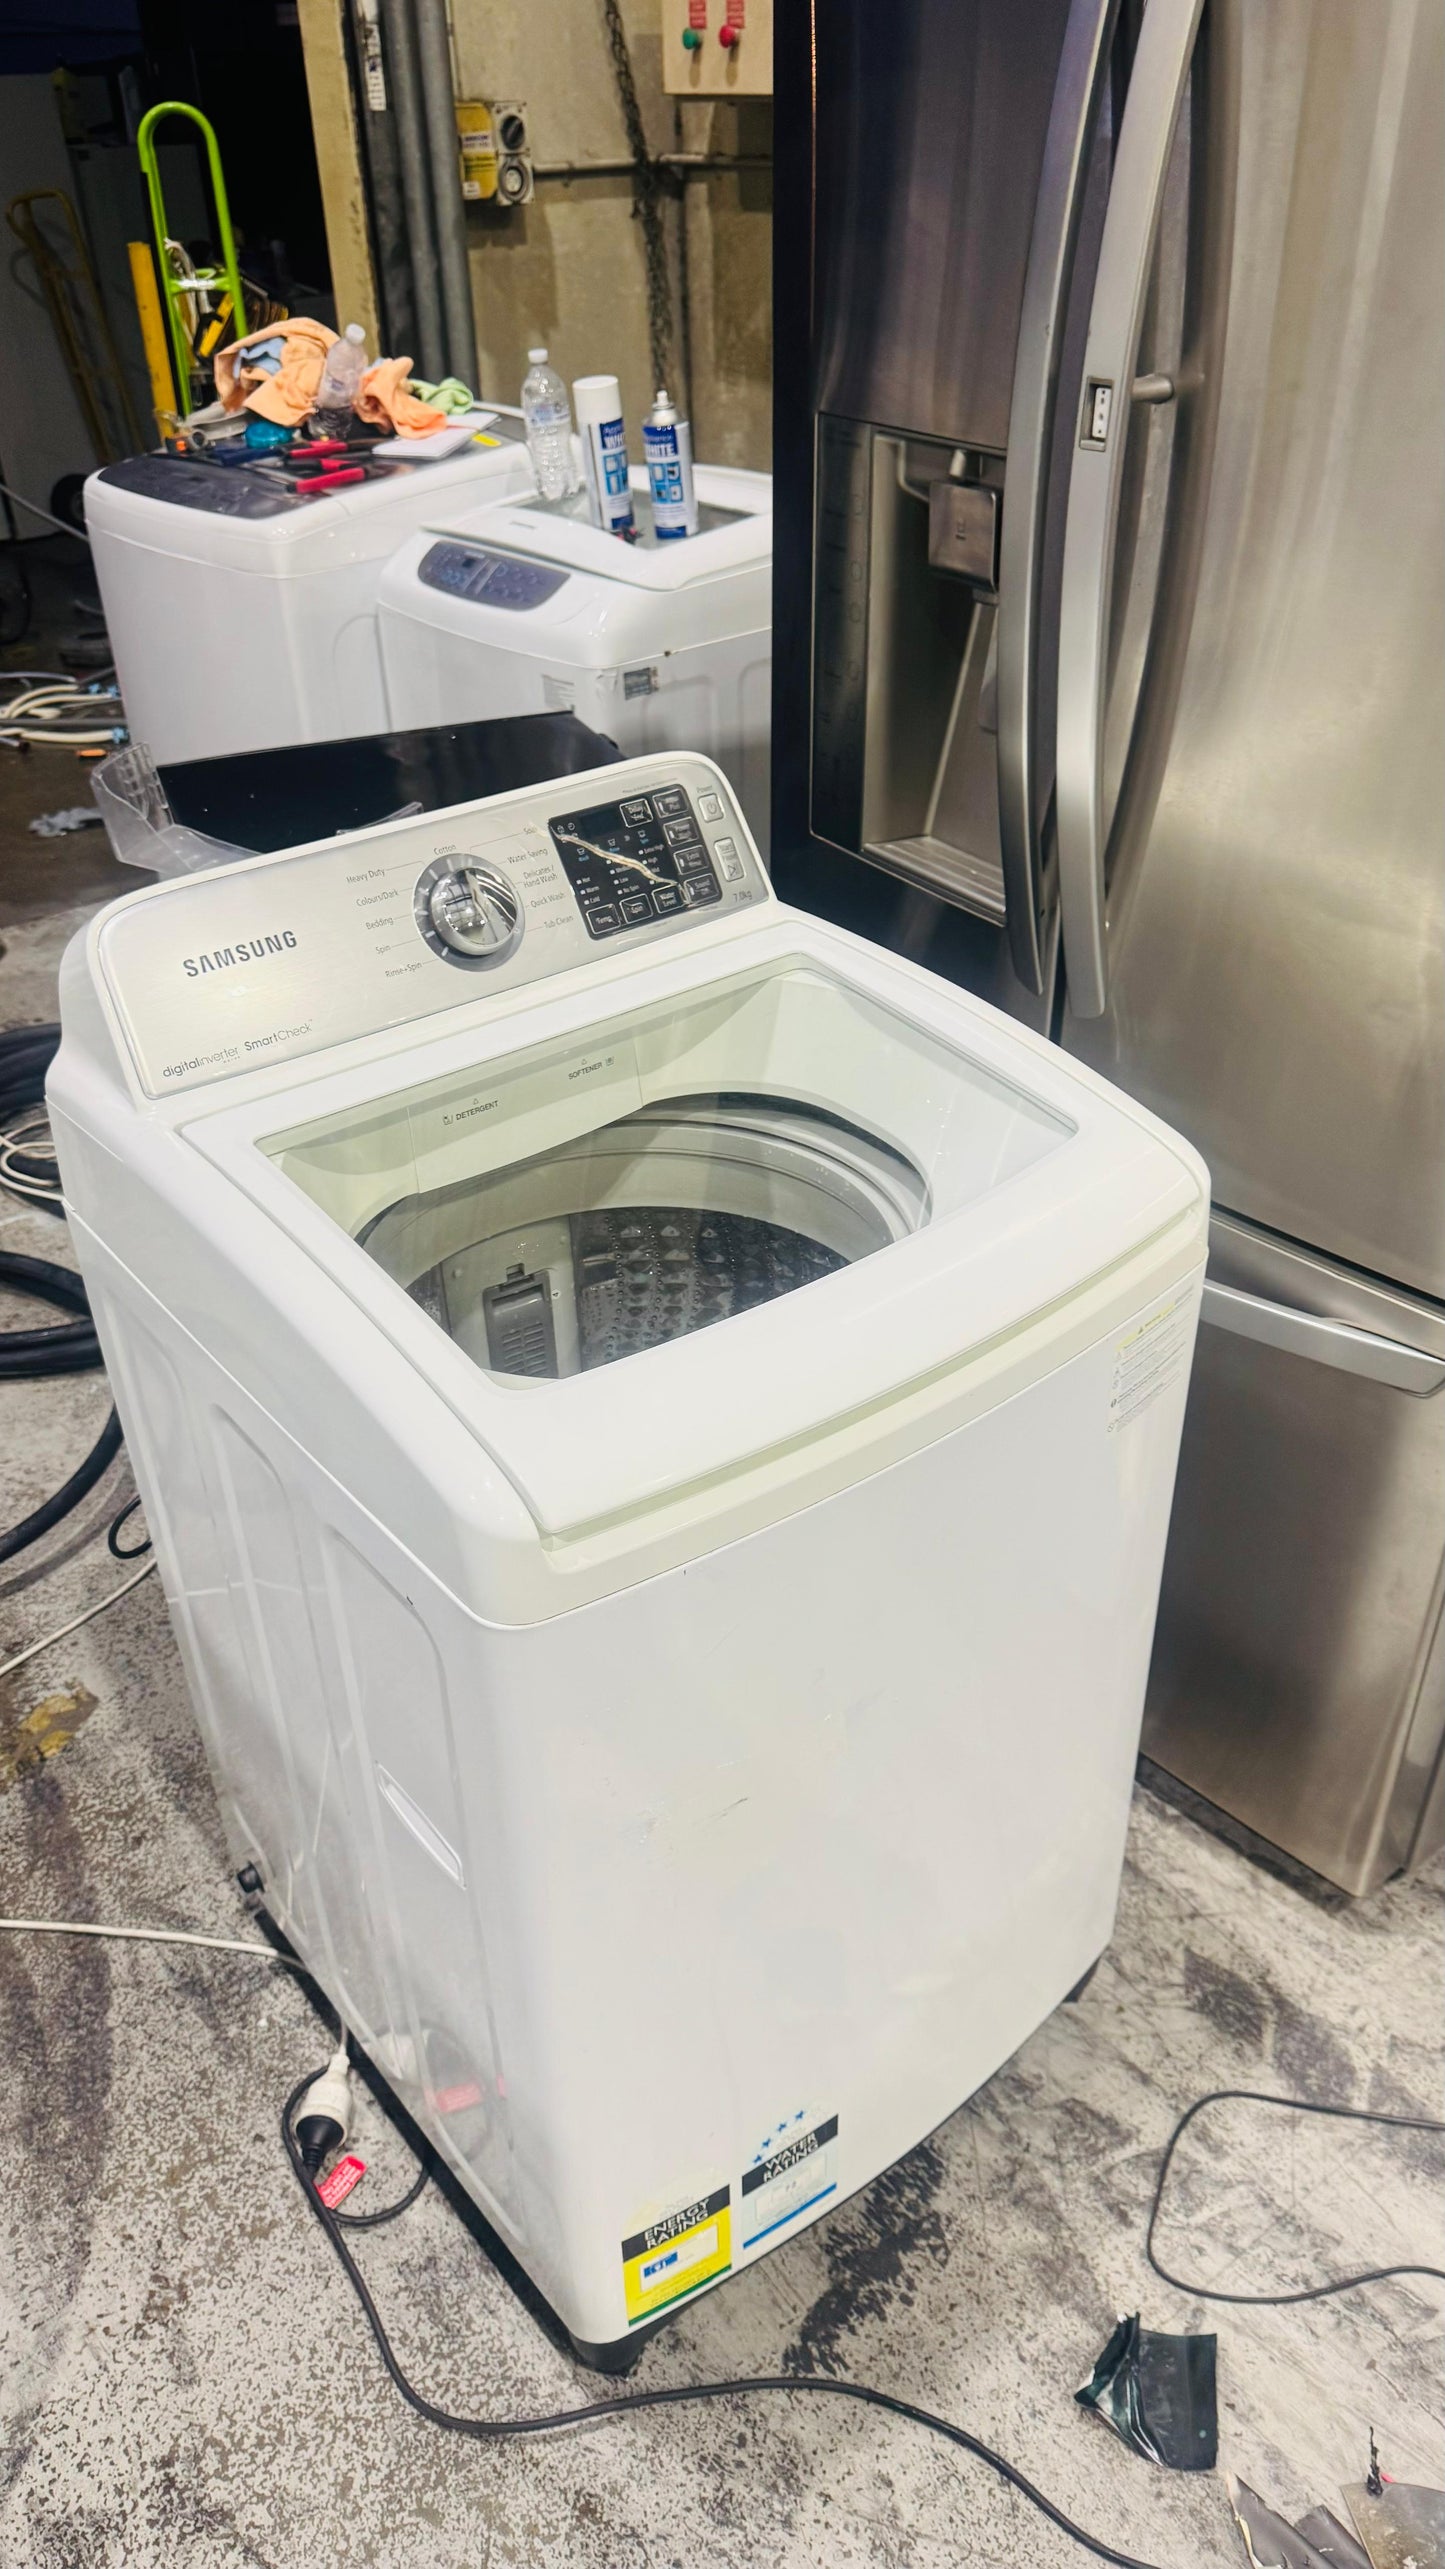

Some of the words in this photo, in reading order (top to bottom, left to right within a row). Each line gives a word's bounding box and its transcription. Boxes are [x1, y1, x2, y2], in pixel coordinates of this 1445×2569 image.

[433, 844, 457, 856] Cotton
[507, 854, 527, 864] Water
[527, 848, 548, 858] Saving
[346, 870, 369, 884] Heavy
[368, 868, 386, 880] Duty
[524, 878, 540, 888] Hand
[540, 873, 558, 883] Wash
[356, 889, 399, 907] Colours/Dark
[530, 898, 547, 908] Quick
[547, 892, 564, 902] Wash
[366, 915, 394, 931] Bedding
[544, 918, 555, 928] Tub
[556, 915, 574, 924] Clean
[182, 930, 299, 978] SAMSUNG
[375, 944, 391, 955] Spin
[385, 961, 423, 978] Rinse+Spin
[243, 1020, 313, 1052] SmartCheck
[568, 1062, 603, 1080] SOFTENER
[456, 1100, 499, 1121] DETERGENT
[765, 2132, 817, 2169] WATER
[763, 2141, 818, 2182] RATING
[644, 2197, 710, 2242] ENERGY
[646, 2210, 708, 2250] RATING
